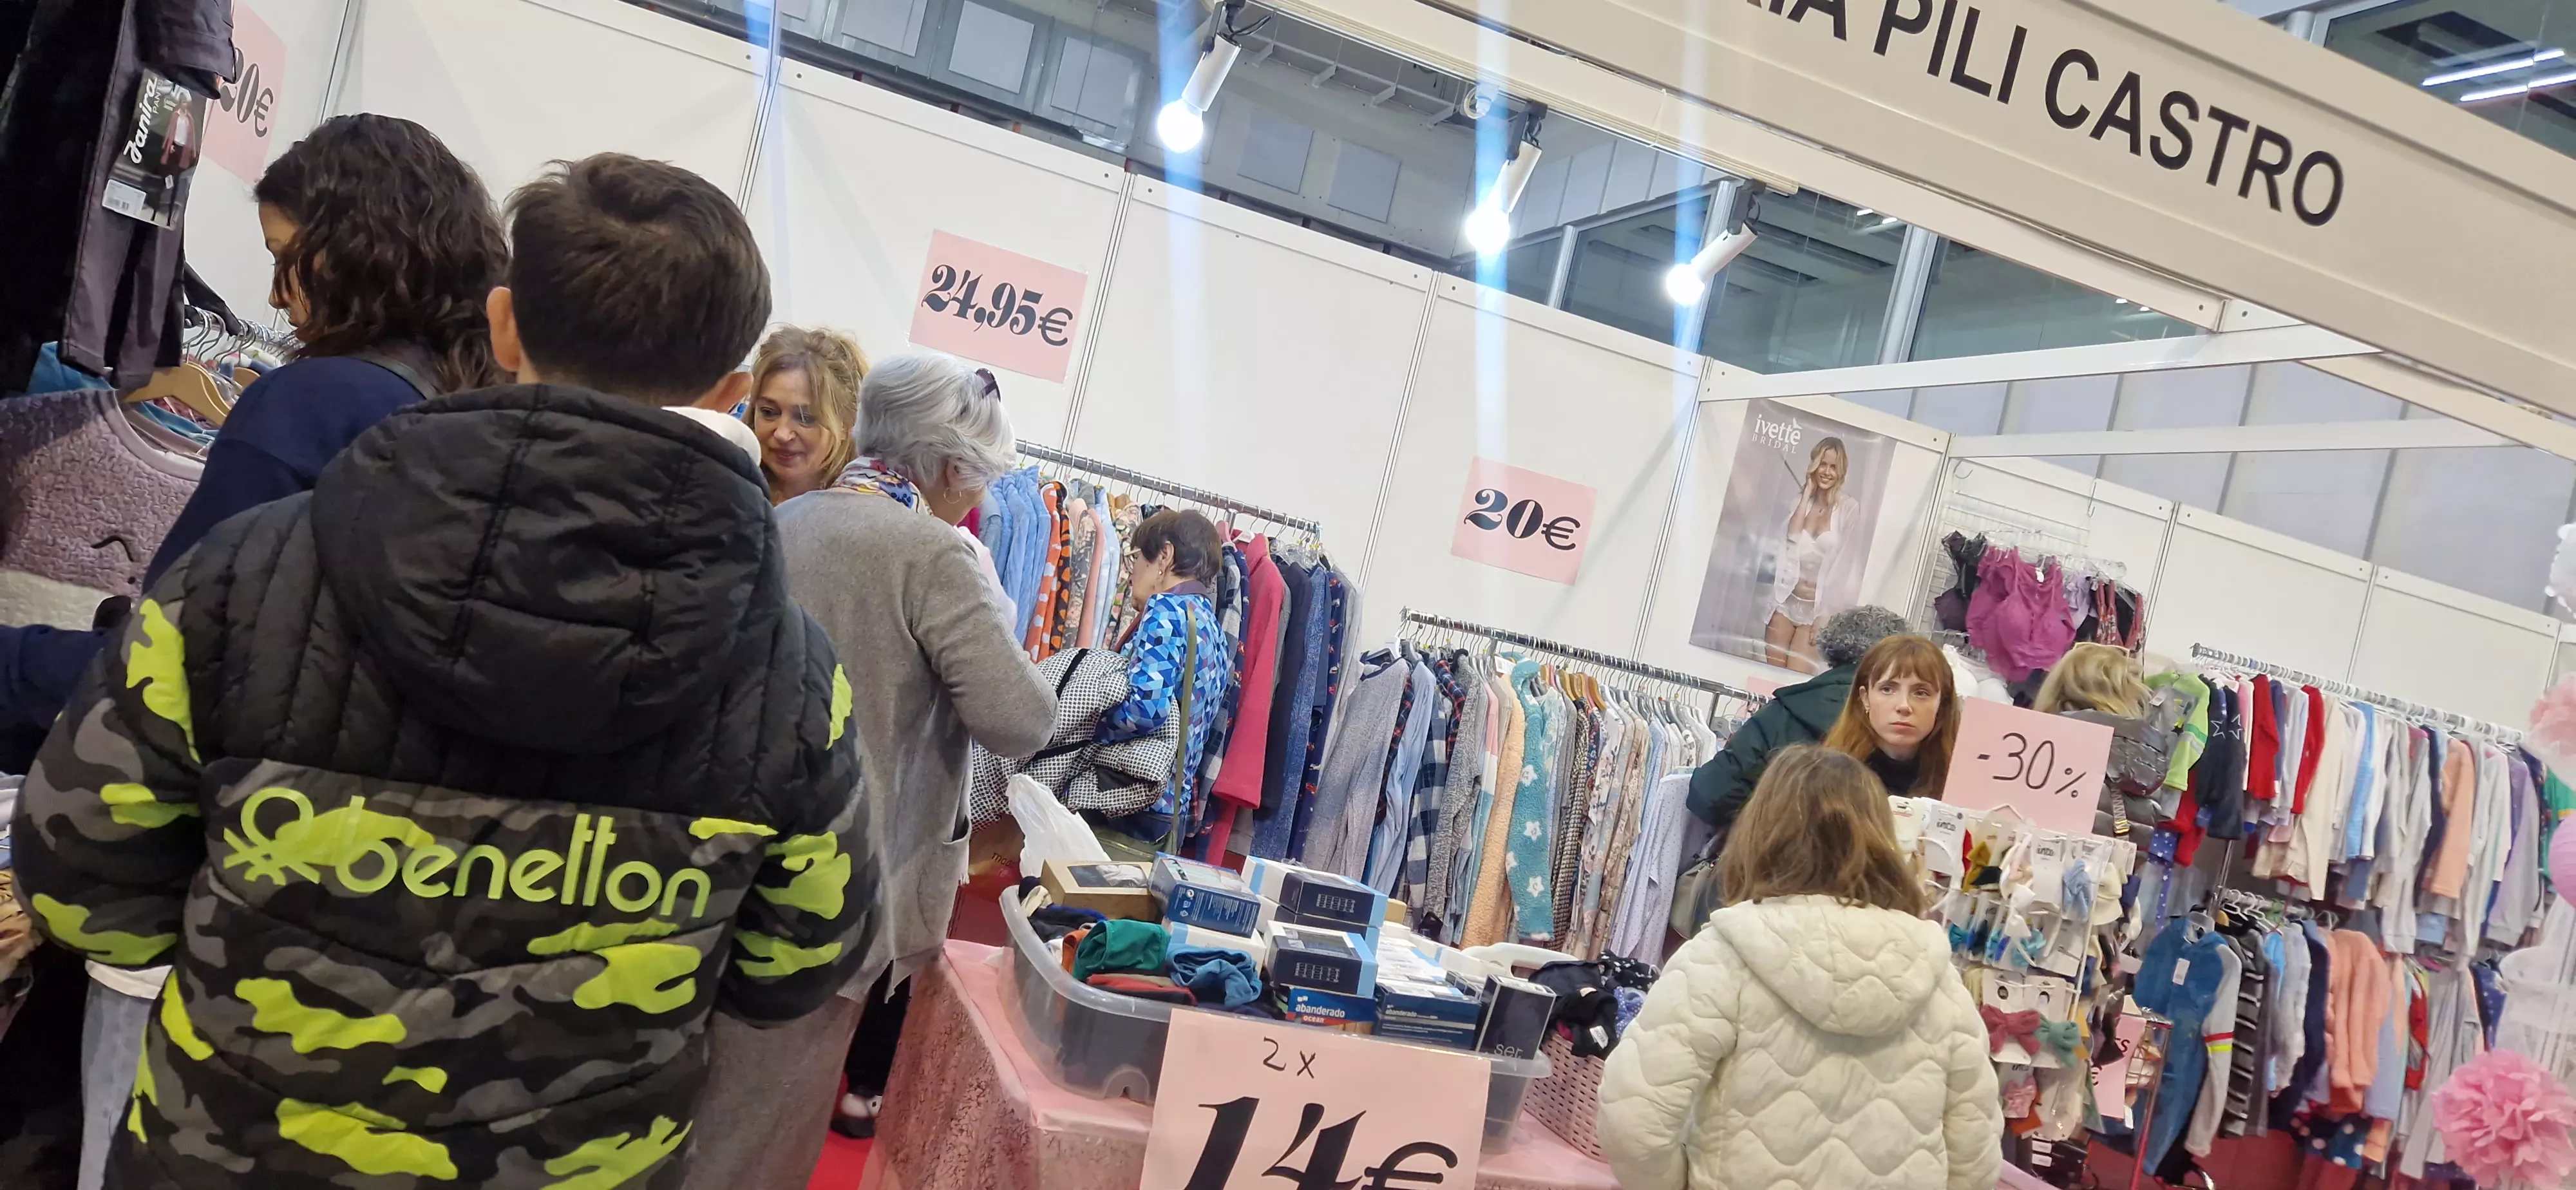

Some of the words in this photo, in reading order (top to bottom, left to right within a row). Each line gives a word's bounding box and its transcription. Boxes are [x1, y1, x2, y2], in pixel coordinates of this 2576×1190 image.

[123, 76, 158, 164] Janira
[1872, 0, 2028, 105] PILI
[2044, 48, 2344, 227] CASTRO
[920, 264, 1074, 346] 24,95€
[1752, 433, 1797, 454] BRIDAL
[1754, 413, 1801, 446] ivette
[1463, 488, 1581, 551] 20€
[1976, 732, 2087, 798] -30%
[335, 795, 712, 918] benetton
[1295, 1003, 1345, 1019] abanderado
[1302, 1015, 1325, 1024] ocean
[1262, 1035, 1287, 1072] 2
